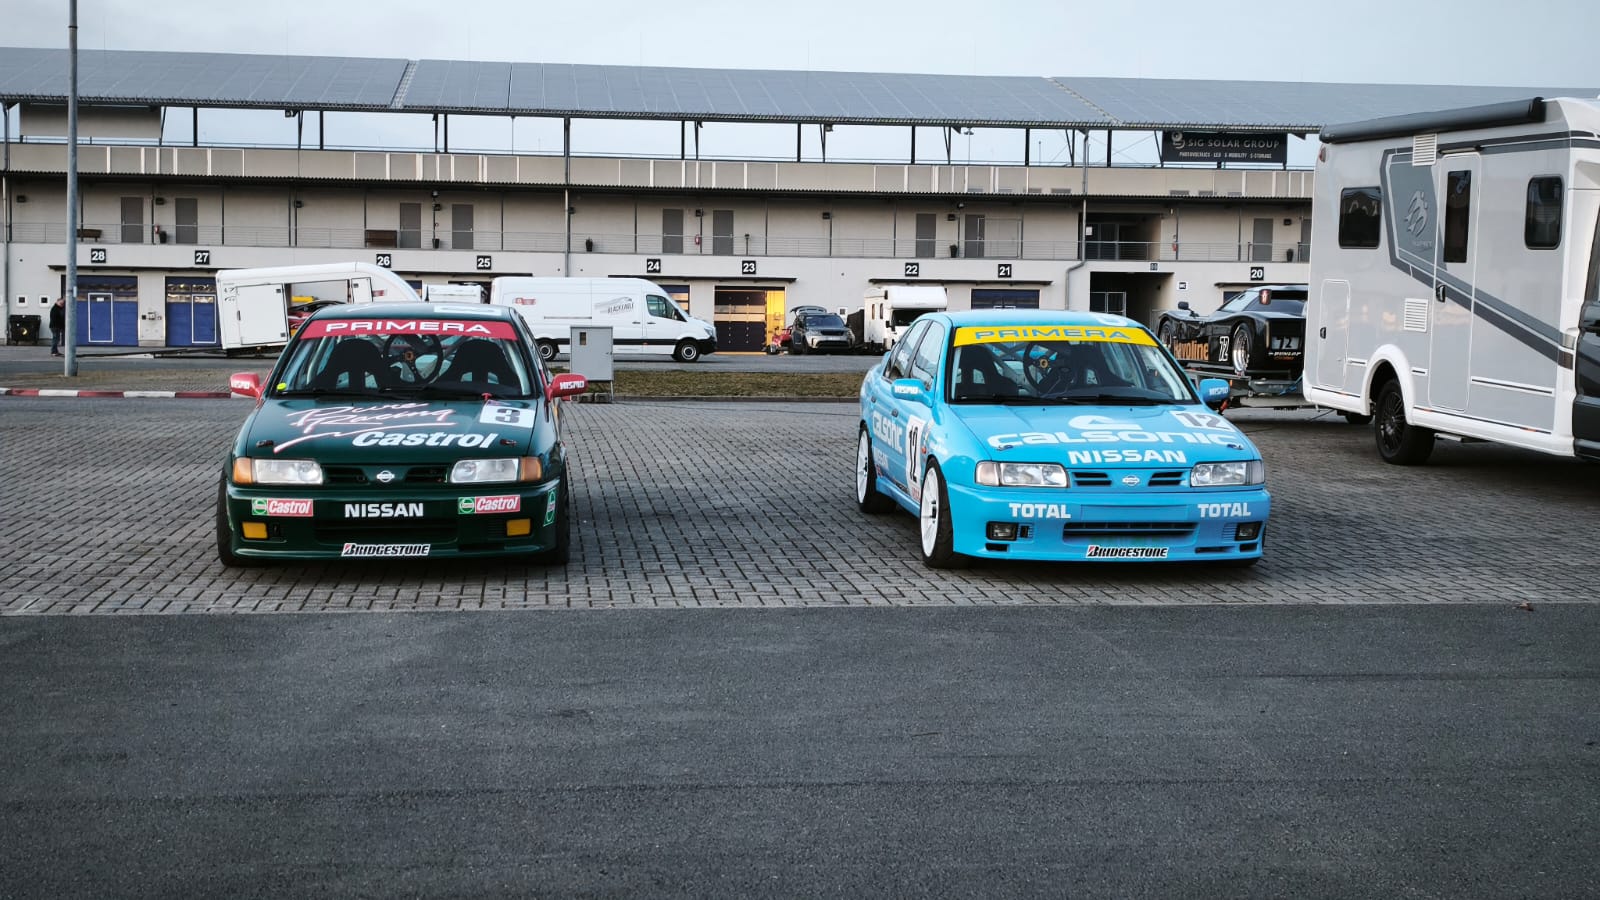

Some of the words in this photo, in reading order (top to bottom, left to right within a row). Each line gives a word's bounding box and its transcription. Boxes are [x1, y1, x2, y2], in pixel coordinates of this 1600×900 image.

[1188, 139, 1204, 147] SIG
[1207, 139, 1240, 148] SOLAR
[1243, 140, 1280, 149] GROUP
[91, 250, 105, 261] 28
[195, 252, 209, 263] 27
[377, 256, 390, 266] 26
[477, 257, 491, 268] 25
[647, 261, 660, 271] 24
[743, 262, 756, 273] 23
[905, 265, 918, 275] 22
[999, 266, 1011, 276] 21
[1251, 269, 1263, 279] 20
[326, 321, 491, 333] PRIMERA
[975, 329, 1131, 340] PRIMERA
[1219, 336, 1230, 361] 72
[496, 408, 521, 423] 3
[1175, 412, 1231, 430] 12
[352, 430, 498, 449] Castrol
[909, 426, 919, 483] 12
[1067, 450, 1187, 464] NISSAN
[268, 500, 311, 514] Castrol
[477, 497, 519, 511] Castrol
[1197, 502, 1251, 518] TOTAL
[344, 503, 424, 518] NISSAN
[1009, 503, 1071, 519] TOTAL
[344, 543, 430, 555] BRIDGESTONE
[1087, 545, 1168, 557] BRIDGESTONE
